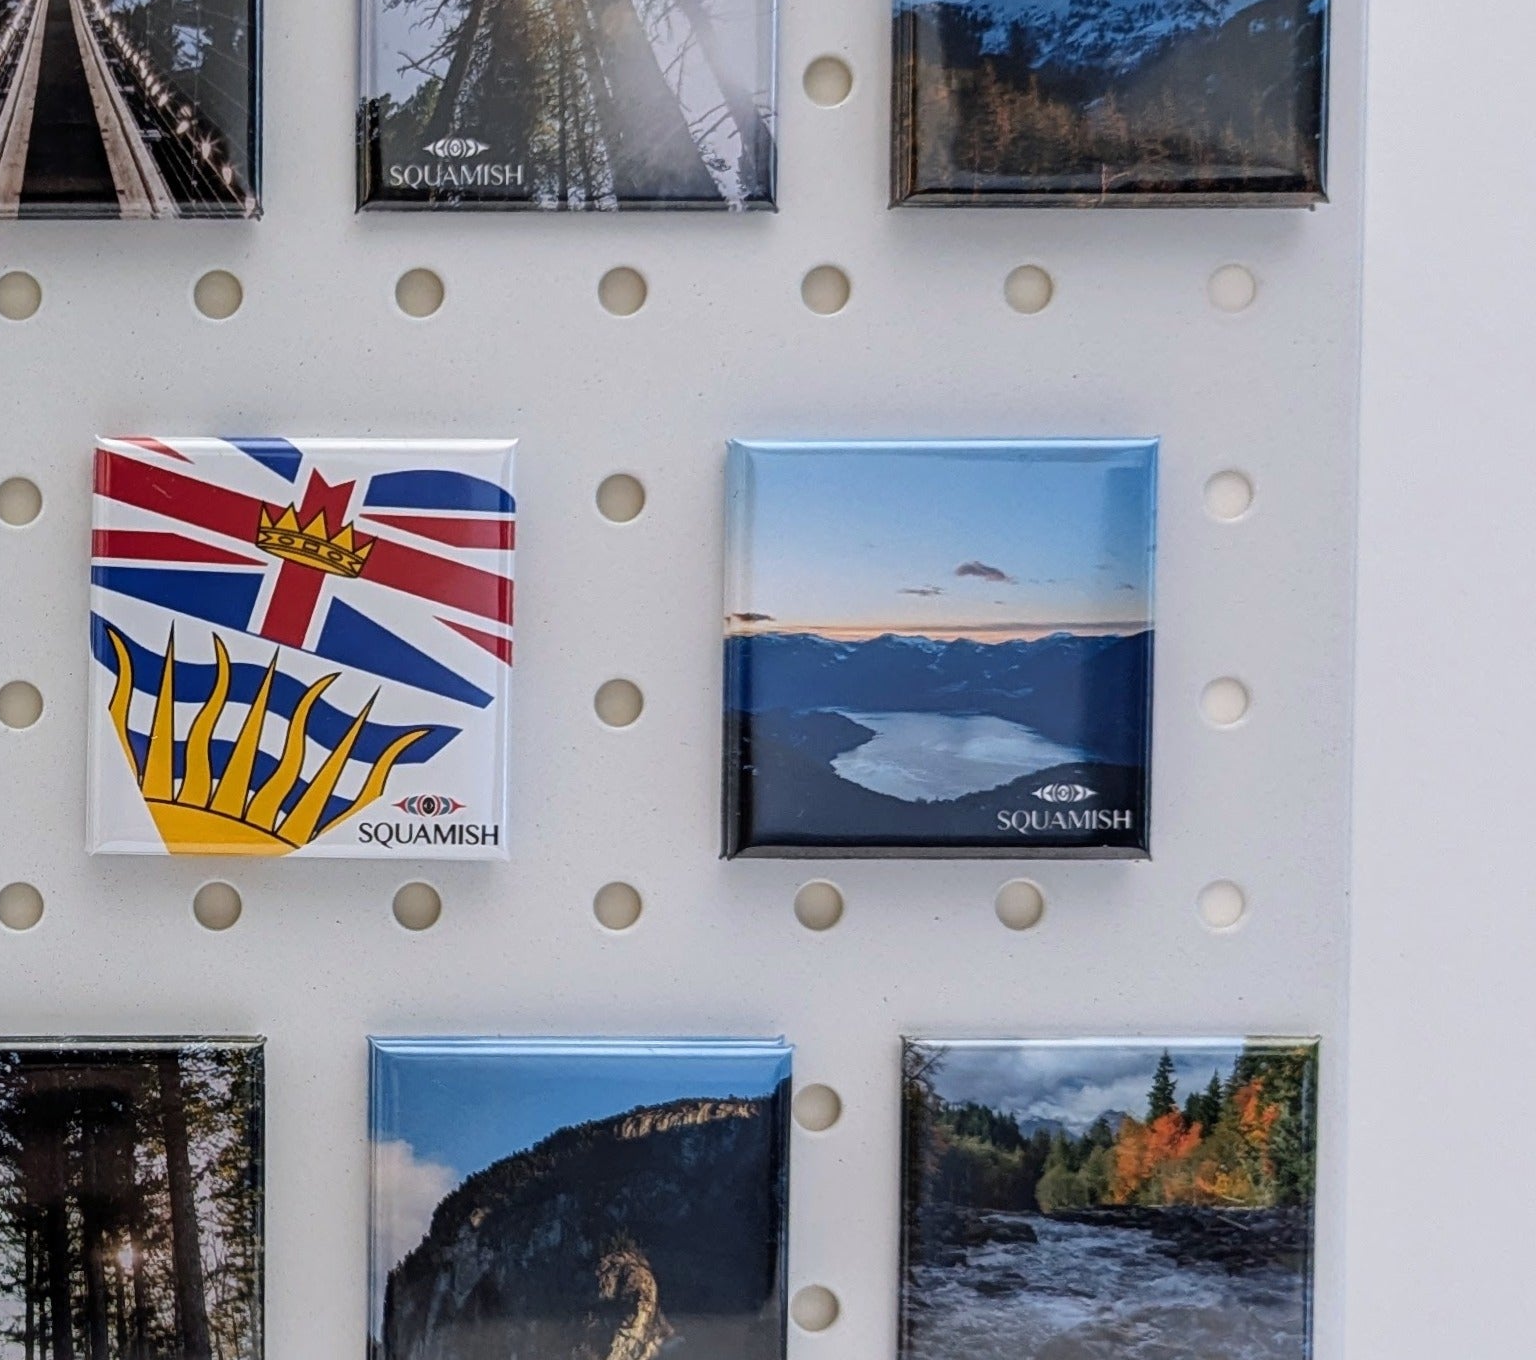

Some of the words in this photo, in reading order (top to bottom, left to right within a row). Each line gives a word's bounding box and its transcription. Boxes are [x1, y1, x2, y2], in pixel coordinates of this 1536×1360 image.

[389, 164, 523, 190] SQUAMISH
[358, 821, 499, 848] SQUAMISH
[996, 809, 1132, 835] SQUAMISH
